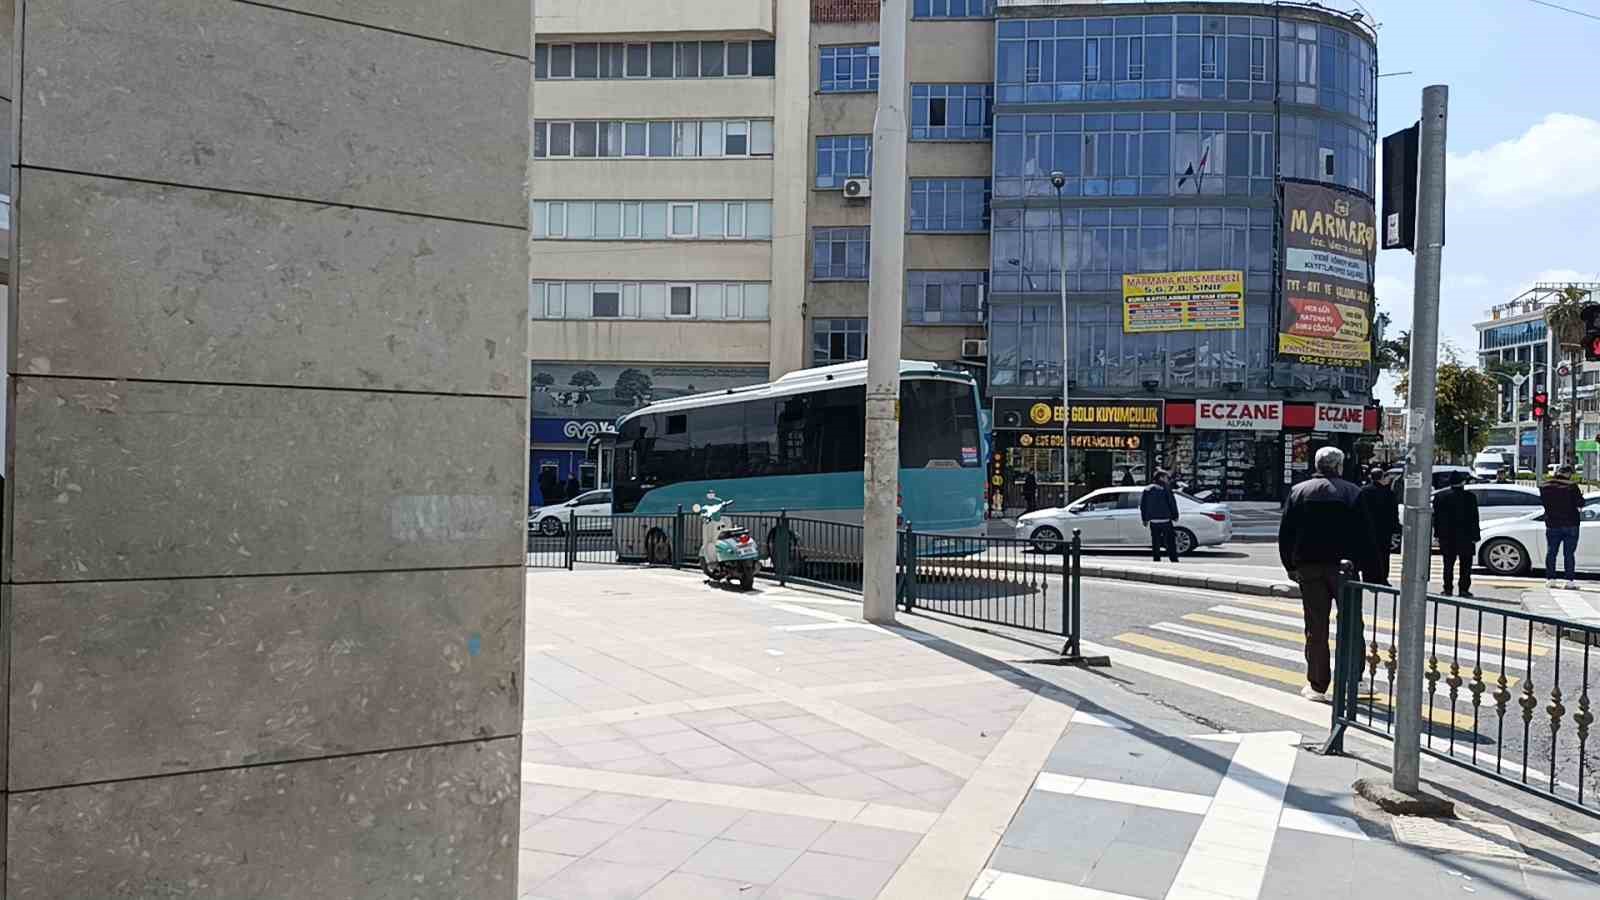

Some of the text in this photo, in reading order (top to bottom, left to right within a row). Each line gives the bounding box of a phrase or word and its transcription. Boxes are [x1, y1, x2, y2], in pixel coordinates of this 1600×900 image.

[1054, 406, 1158, 423] EGE GOLD KUYUMCULUK
[1200, 404, 1279, 420] ECZANE
[1318, 406, 1363, 423] ECZANE
